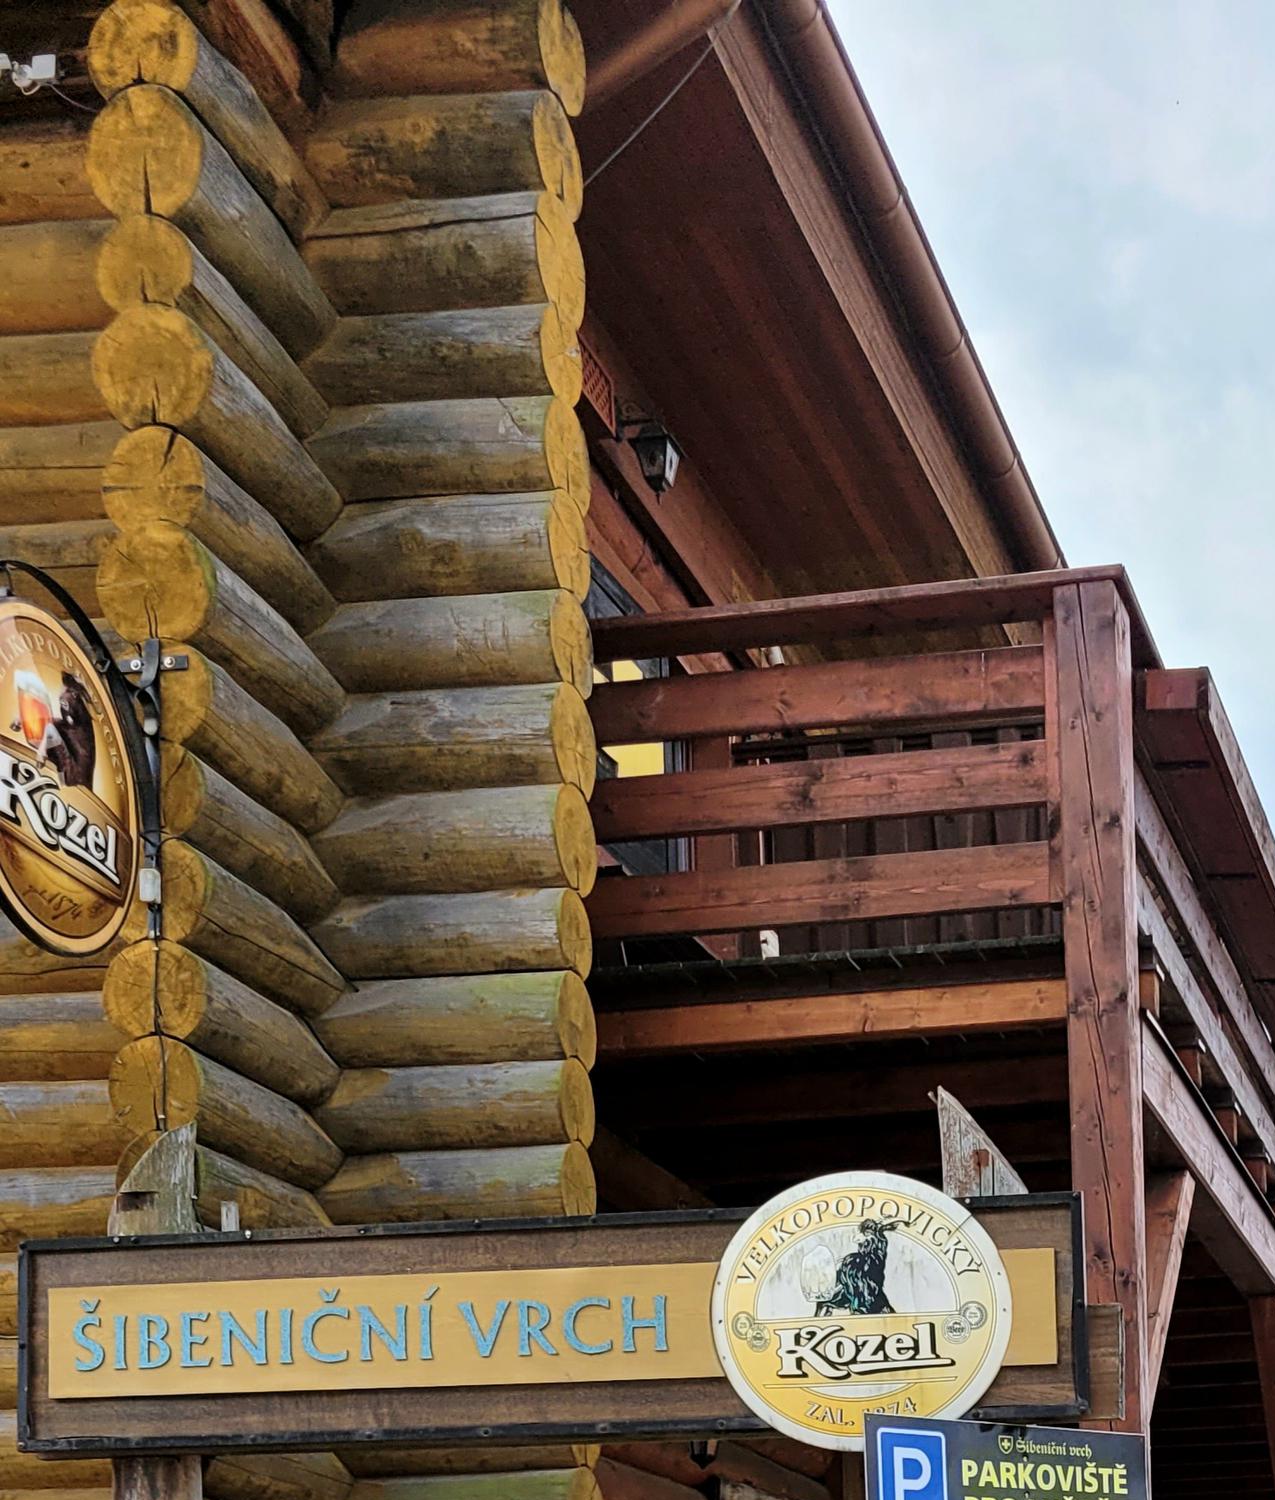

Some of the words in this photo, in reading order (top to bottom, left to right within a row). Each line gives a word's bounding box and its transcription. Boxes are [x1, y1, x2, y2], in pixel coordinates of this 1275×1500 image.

[0, 752, 120, 885] Kozel
[73, 1285, 440, 1372] ŠIBENIČNÍ
[458, 1294, 669, 1359] VRCH
[773, 1321, 956, 1380] Kozel
[805, 1400, 855, 1427] ZAL.
[1015, 1436, 1067, 1456] Šibeniční
[1069, 1443, 1093, 1460] vrch
[961, 1459, 1129, 1495] PARKOVIŠTĚ
